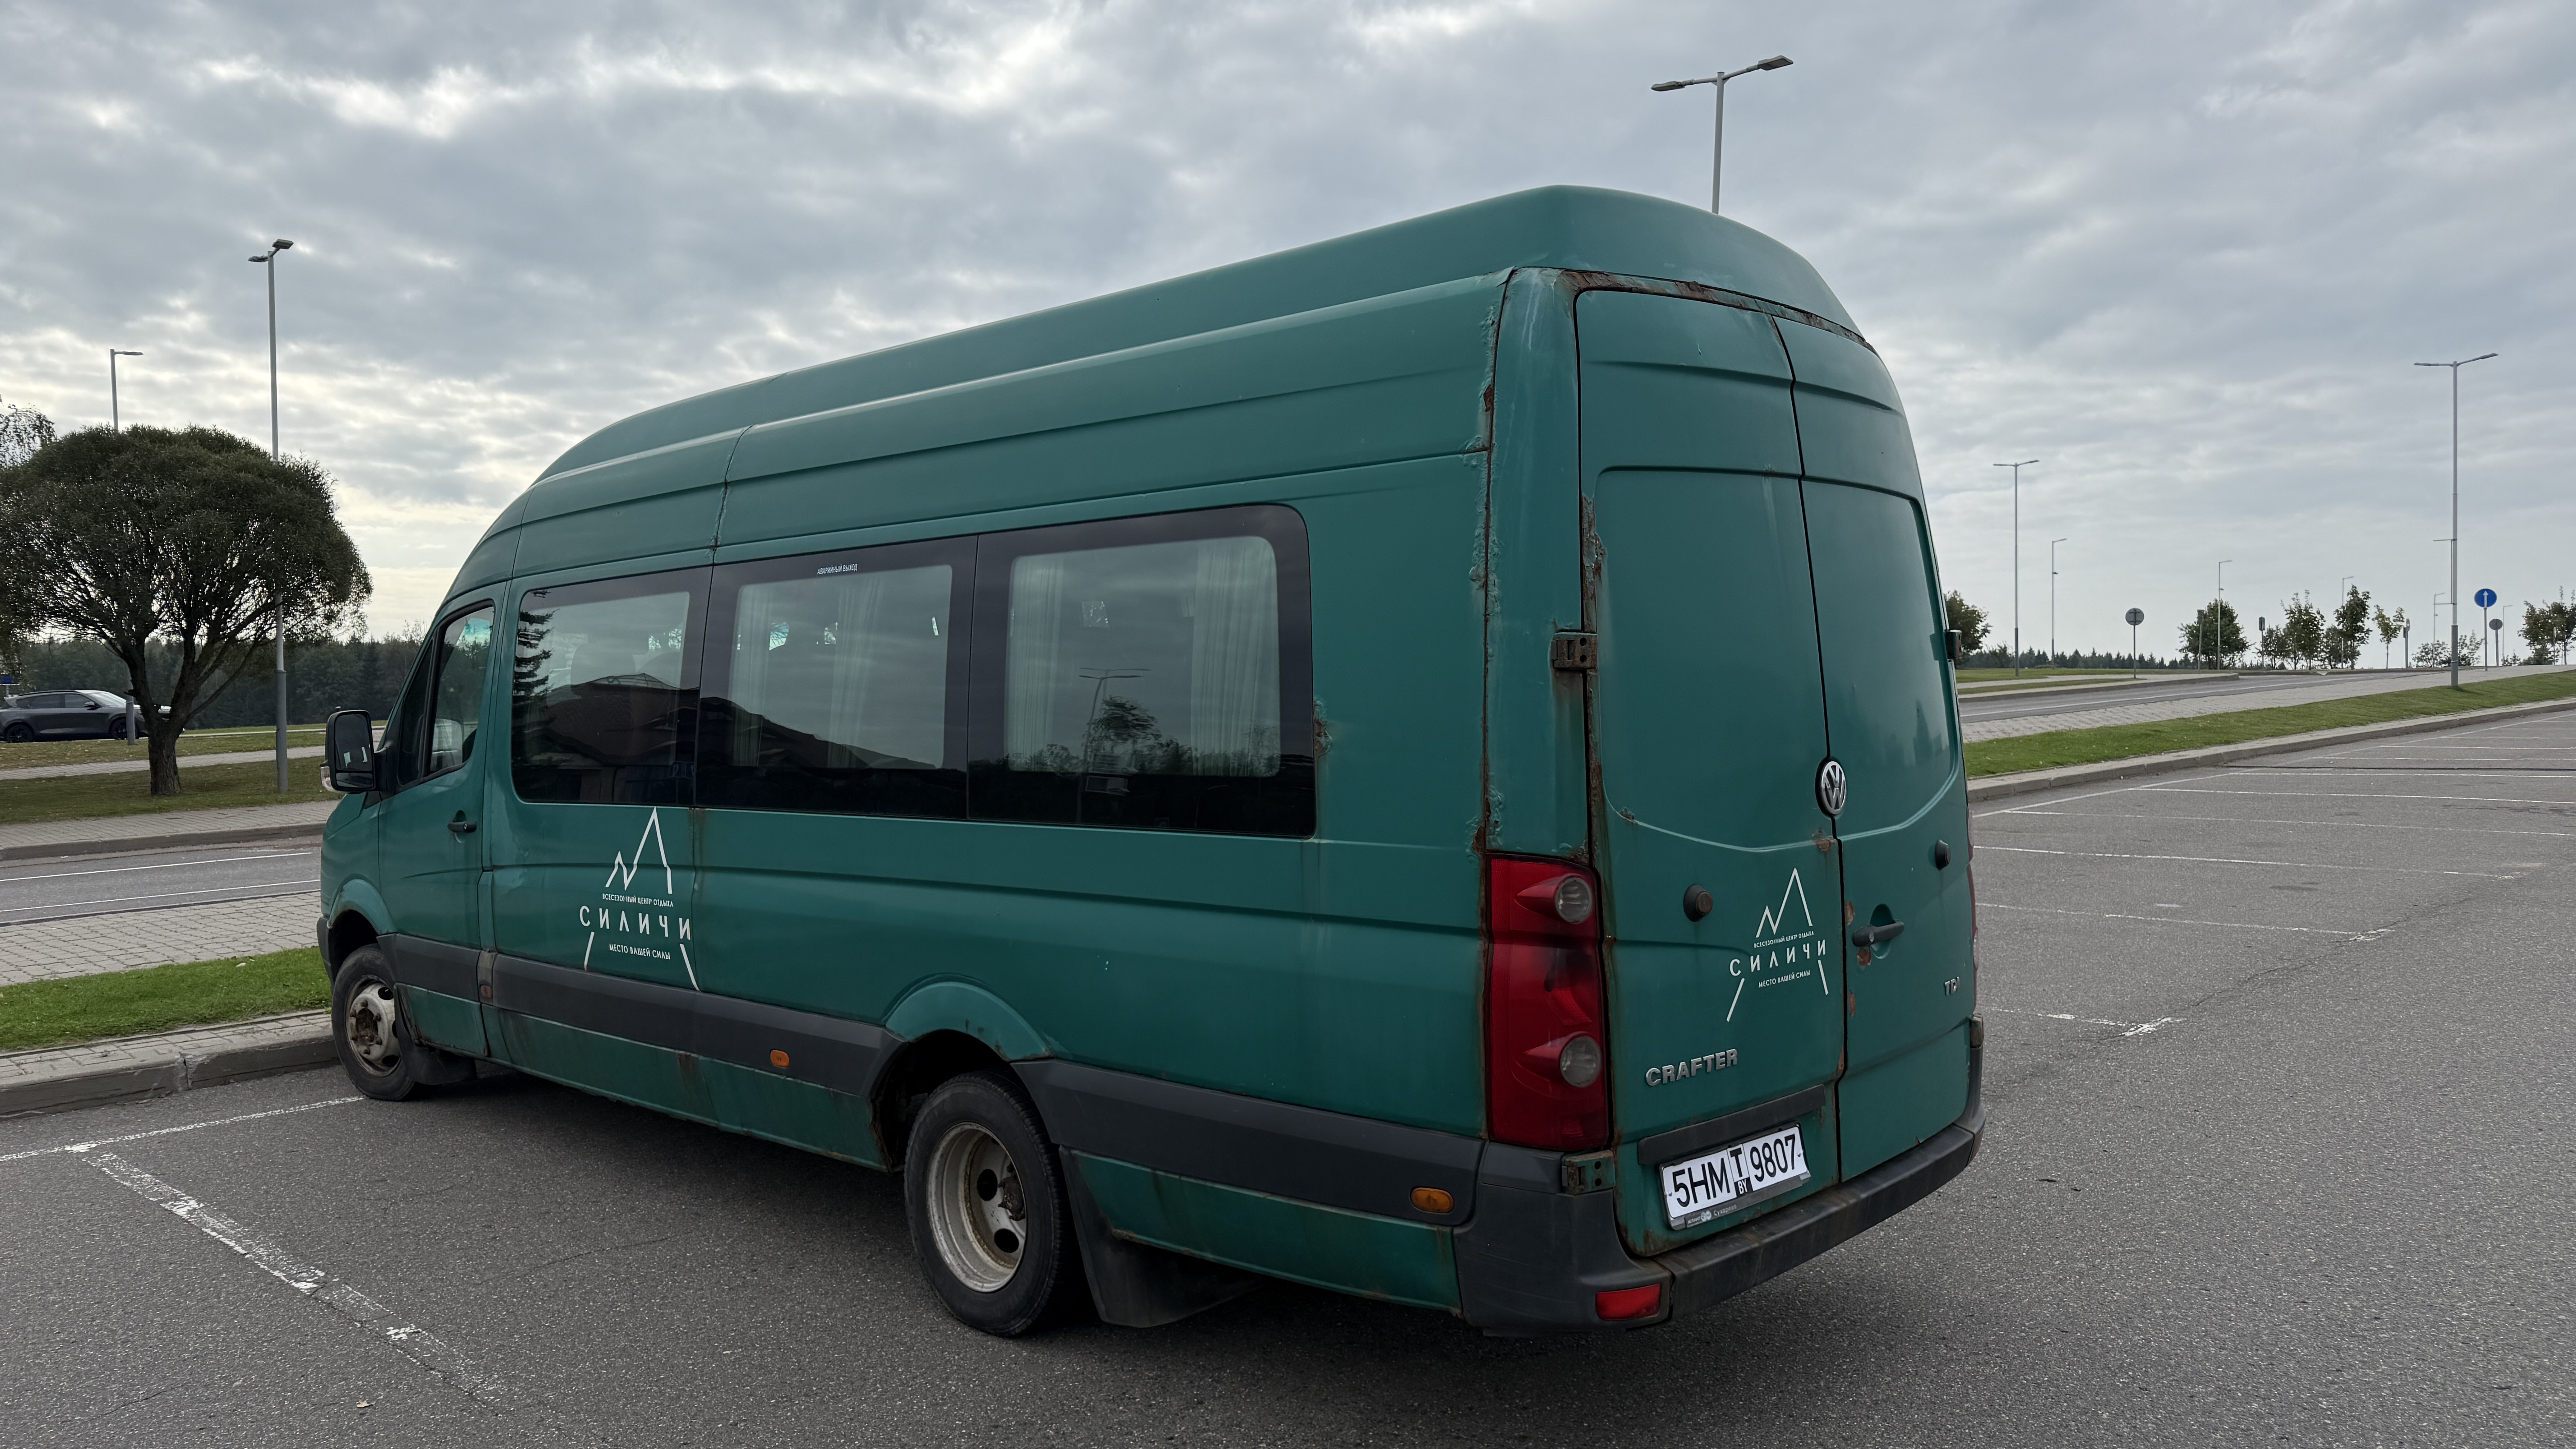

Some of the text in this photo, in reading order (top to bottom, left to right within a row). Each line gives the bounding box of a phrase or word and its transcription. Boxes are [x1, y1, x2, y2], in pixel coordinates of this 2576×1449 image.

[817, 564, 857, 575] АВАРИЙНЫЙ ВЫХОД
[653, 899, 674, 907] ОТДЫХА
[580, 906, 691, 940] СИЛИЧИ
[609, 943, 671, 960] МЕСТО ВАШЕЙ СИЛЫ
[1730, 939, 1826, 976] СИЛИЧИ
[1758, 970, 1810, 988] МЕСТО ВАШЕЙ СИЛЫ
[1645, 1049, 1738, 1086] CRAFTER
[1738, 1178, 1748, 1195] BY
